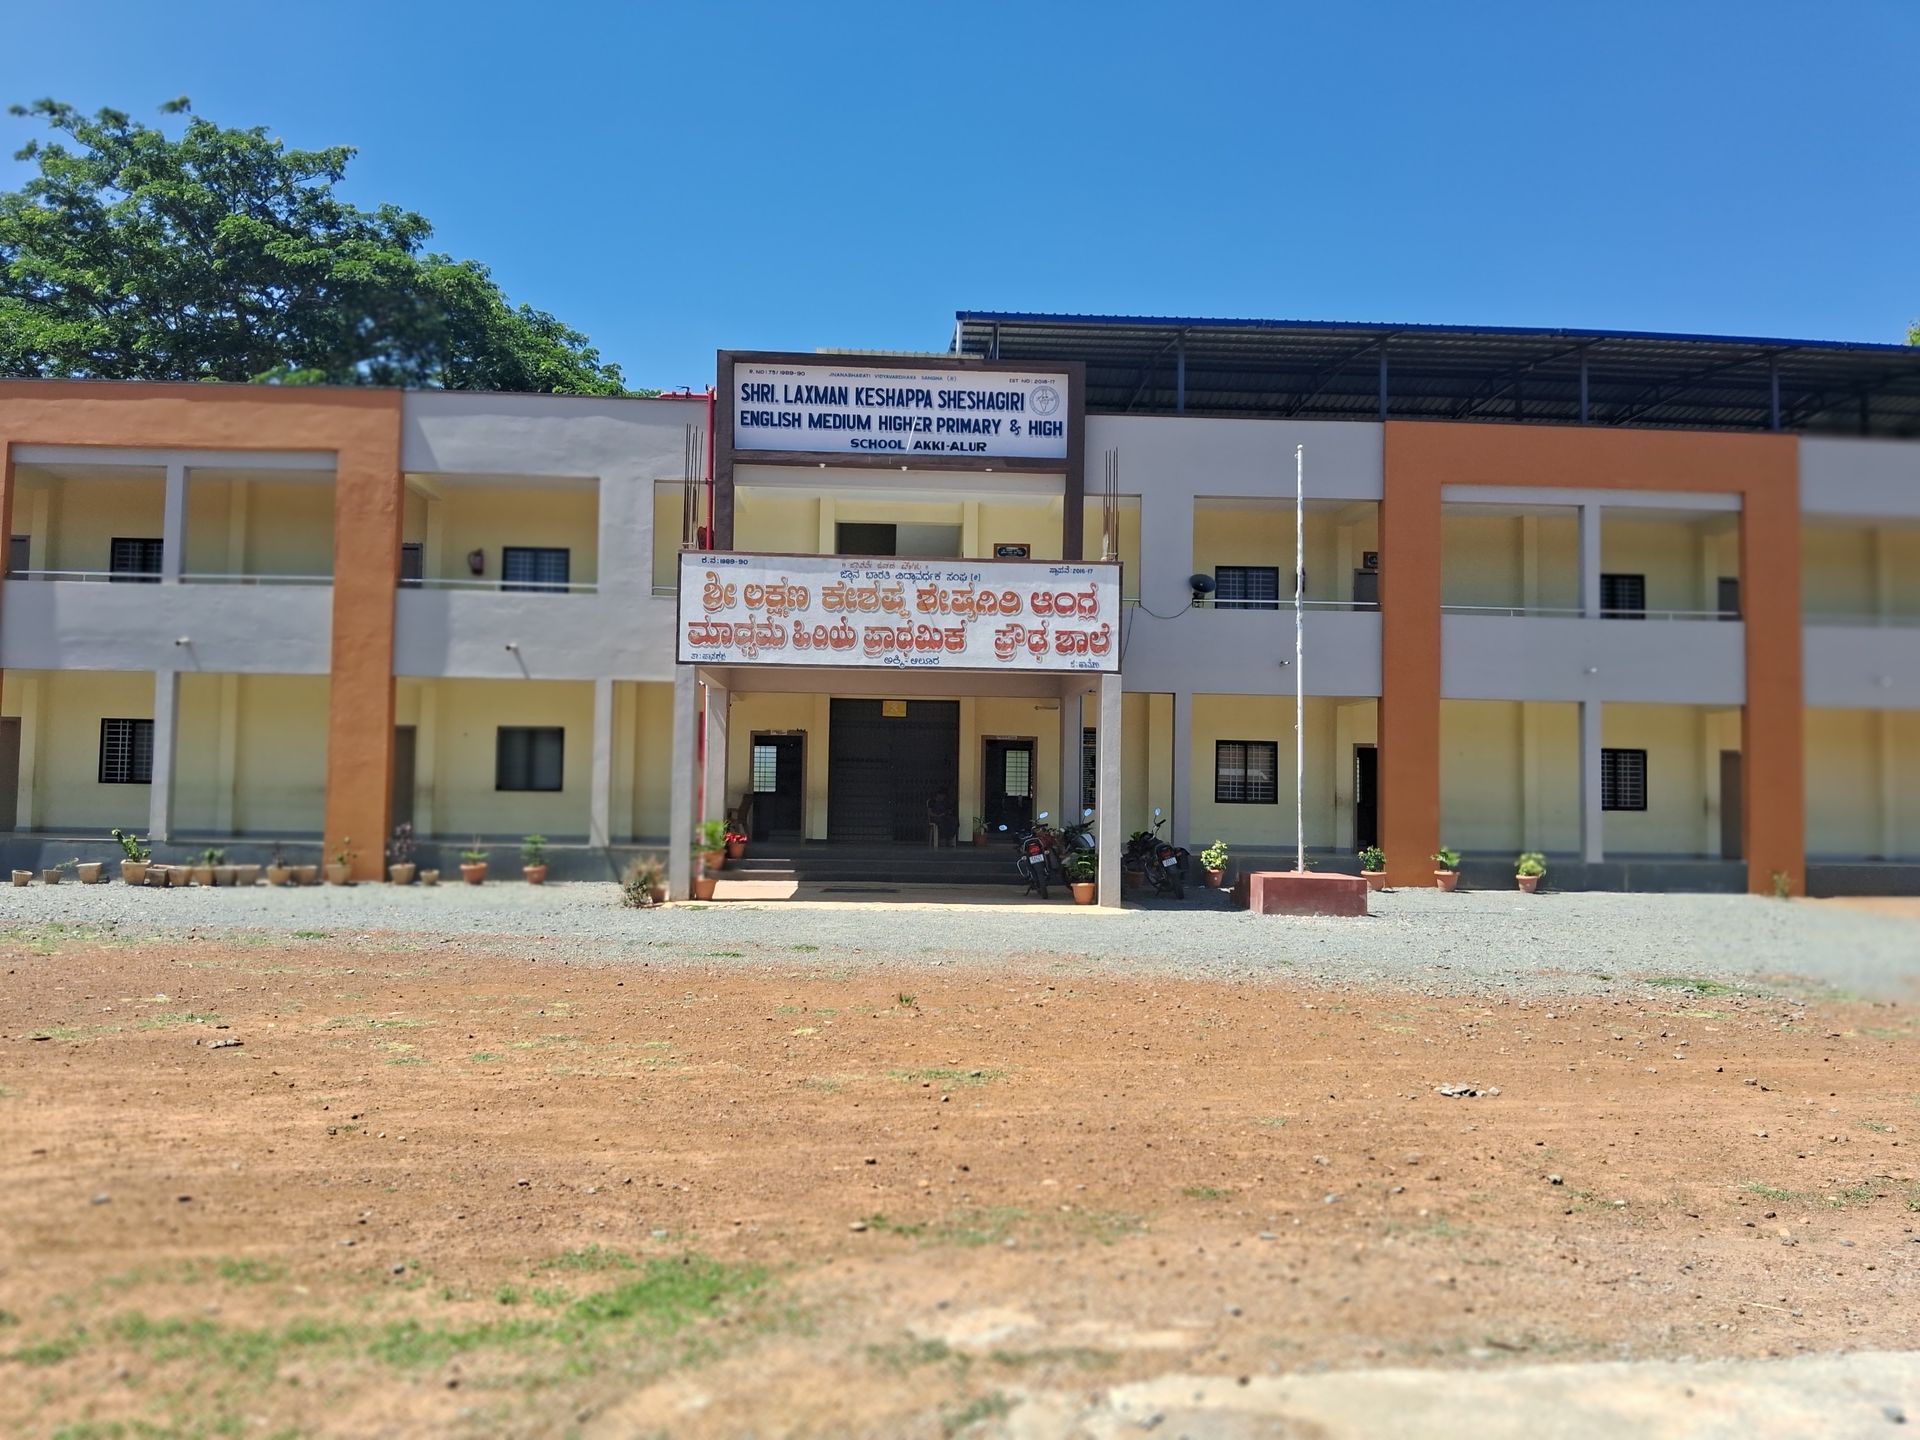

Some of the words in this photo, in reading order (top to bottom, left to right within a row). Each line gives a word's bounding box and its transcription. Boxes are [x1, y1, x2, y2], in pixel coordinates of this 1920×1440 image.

[741, 383, 779, 403] SHRI.
[784, 384, 847, 405] LAXMAN
[855, 387, 933, 409] KESHAPPA
[938, 390, 1024, 411] SHESHAGIRI
[741, 410, 801, 428] ENGLISH
[808, 412, 871, 431] MEDIUM
[879, 415, 932, 433] HIGHER
[937, 417, 1001, 435] PRIMARY
[1010, 419, 1021, 435] &
[1028, 420, 1063, 437] HIGH
[850, 438, 906, 450] SCHOOL
[913, 440, 987, 452] AKKI-ALUR
[703, 571, 738, 613] ಶ್ರೀ
[1030, 583, 1099, 622] ಆಂಗ್ಲ
[687, 614, 788, 659] ಮಾಧ್ಯಮ
[792, 616, 858, 651] ಹಿರಿಯ
[863, 619, 968, 658] ಪ್ರಾಥಮಿಕ
[1055, 622, 1112, 656] ಶಾಲೆ
